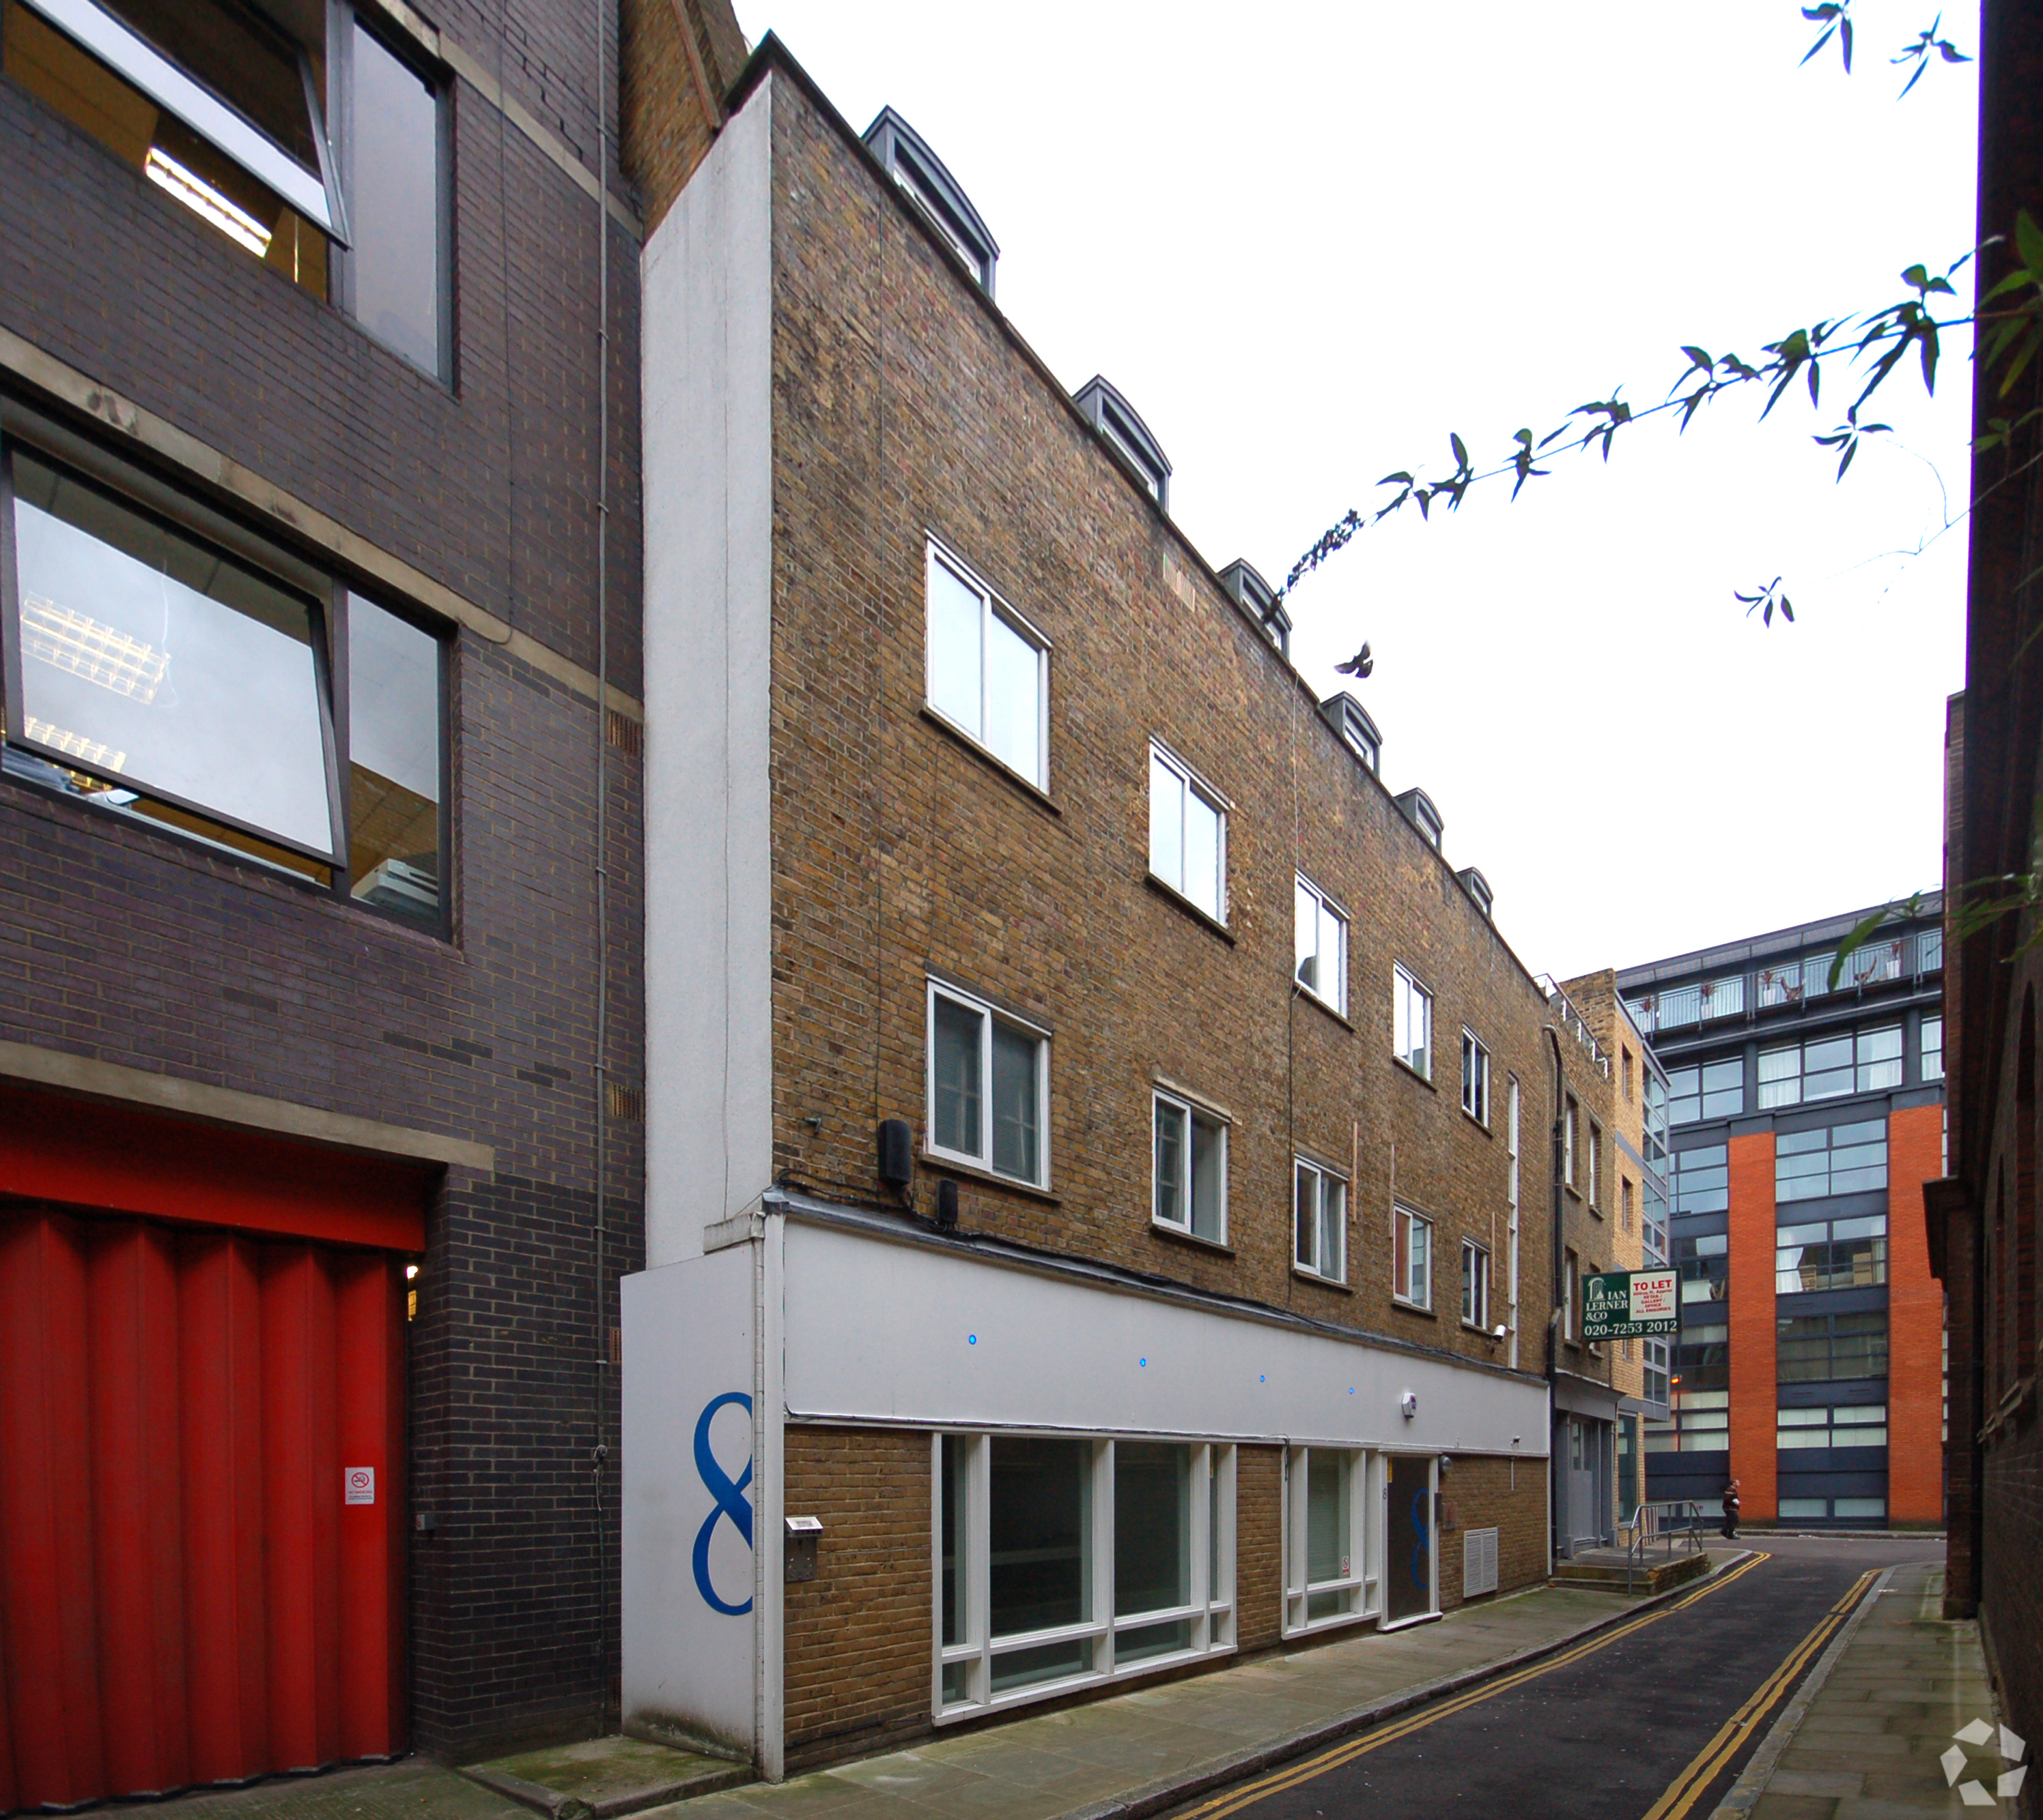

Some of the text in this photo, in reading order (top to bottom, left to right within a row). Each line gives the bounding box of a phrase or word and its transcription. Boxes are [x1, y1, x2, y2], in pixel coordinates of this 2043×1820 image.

[1633, 1279, 1672, 1291] TO LET
[1607, 1290, 1627, 1300] IAN
[1586, 1300, 1629, 1311] LERNER
[1586, 1311, 1608, 1322] &CO
[1584, 1320, 1678, 1336] 020-7253 2012
[692, 1391, 752, 1616] 8
